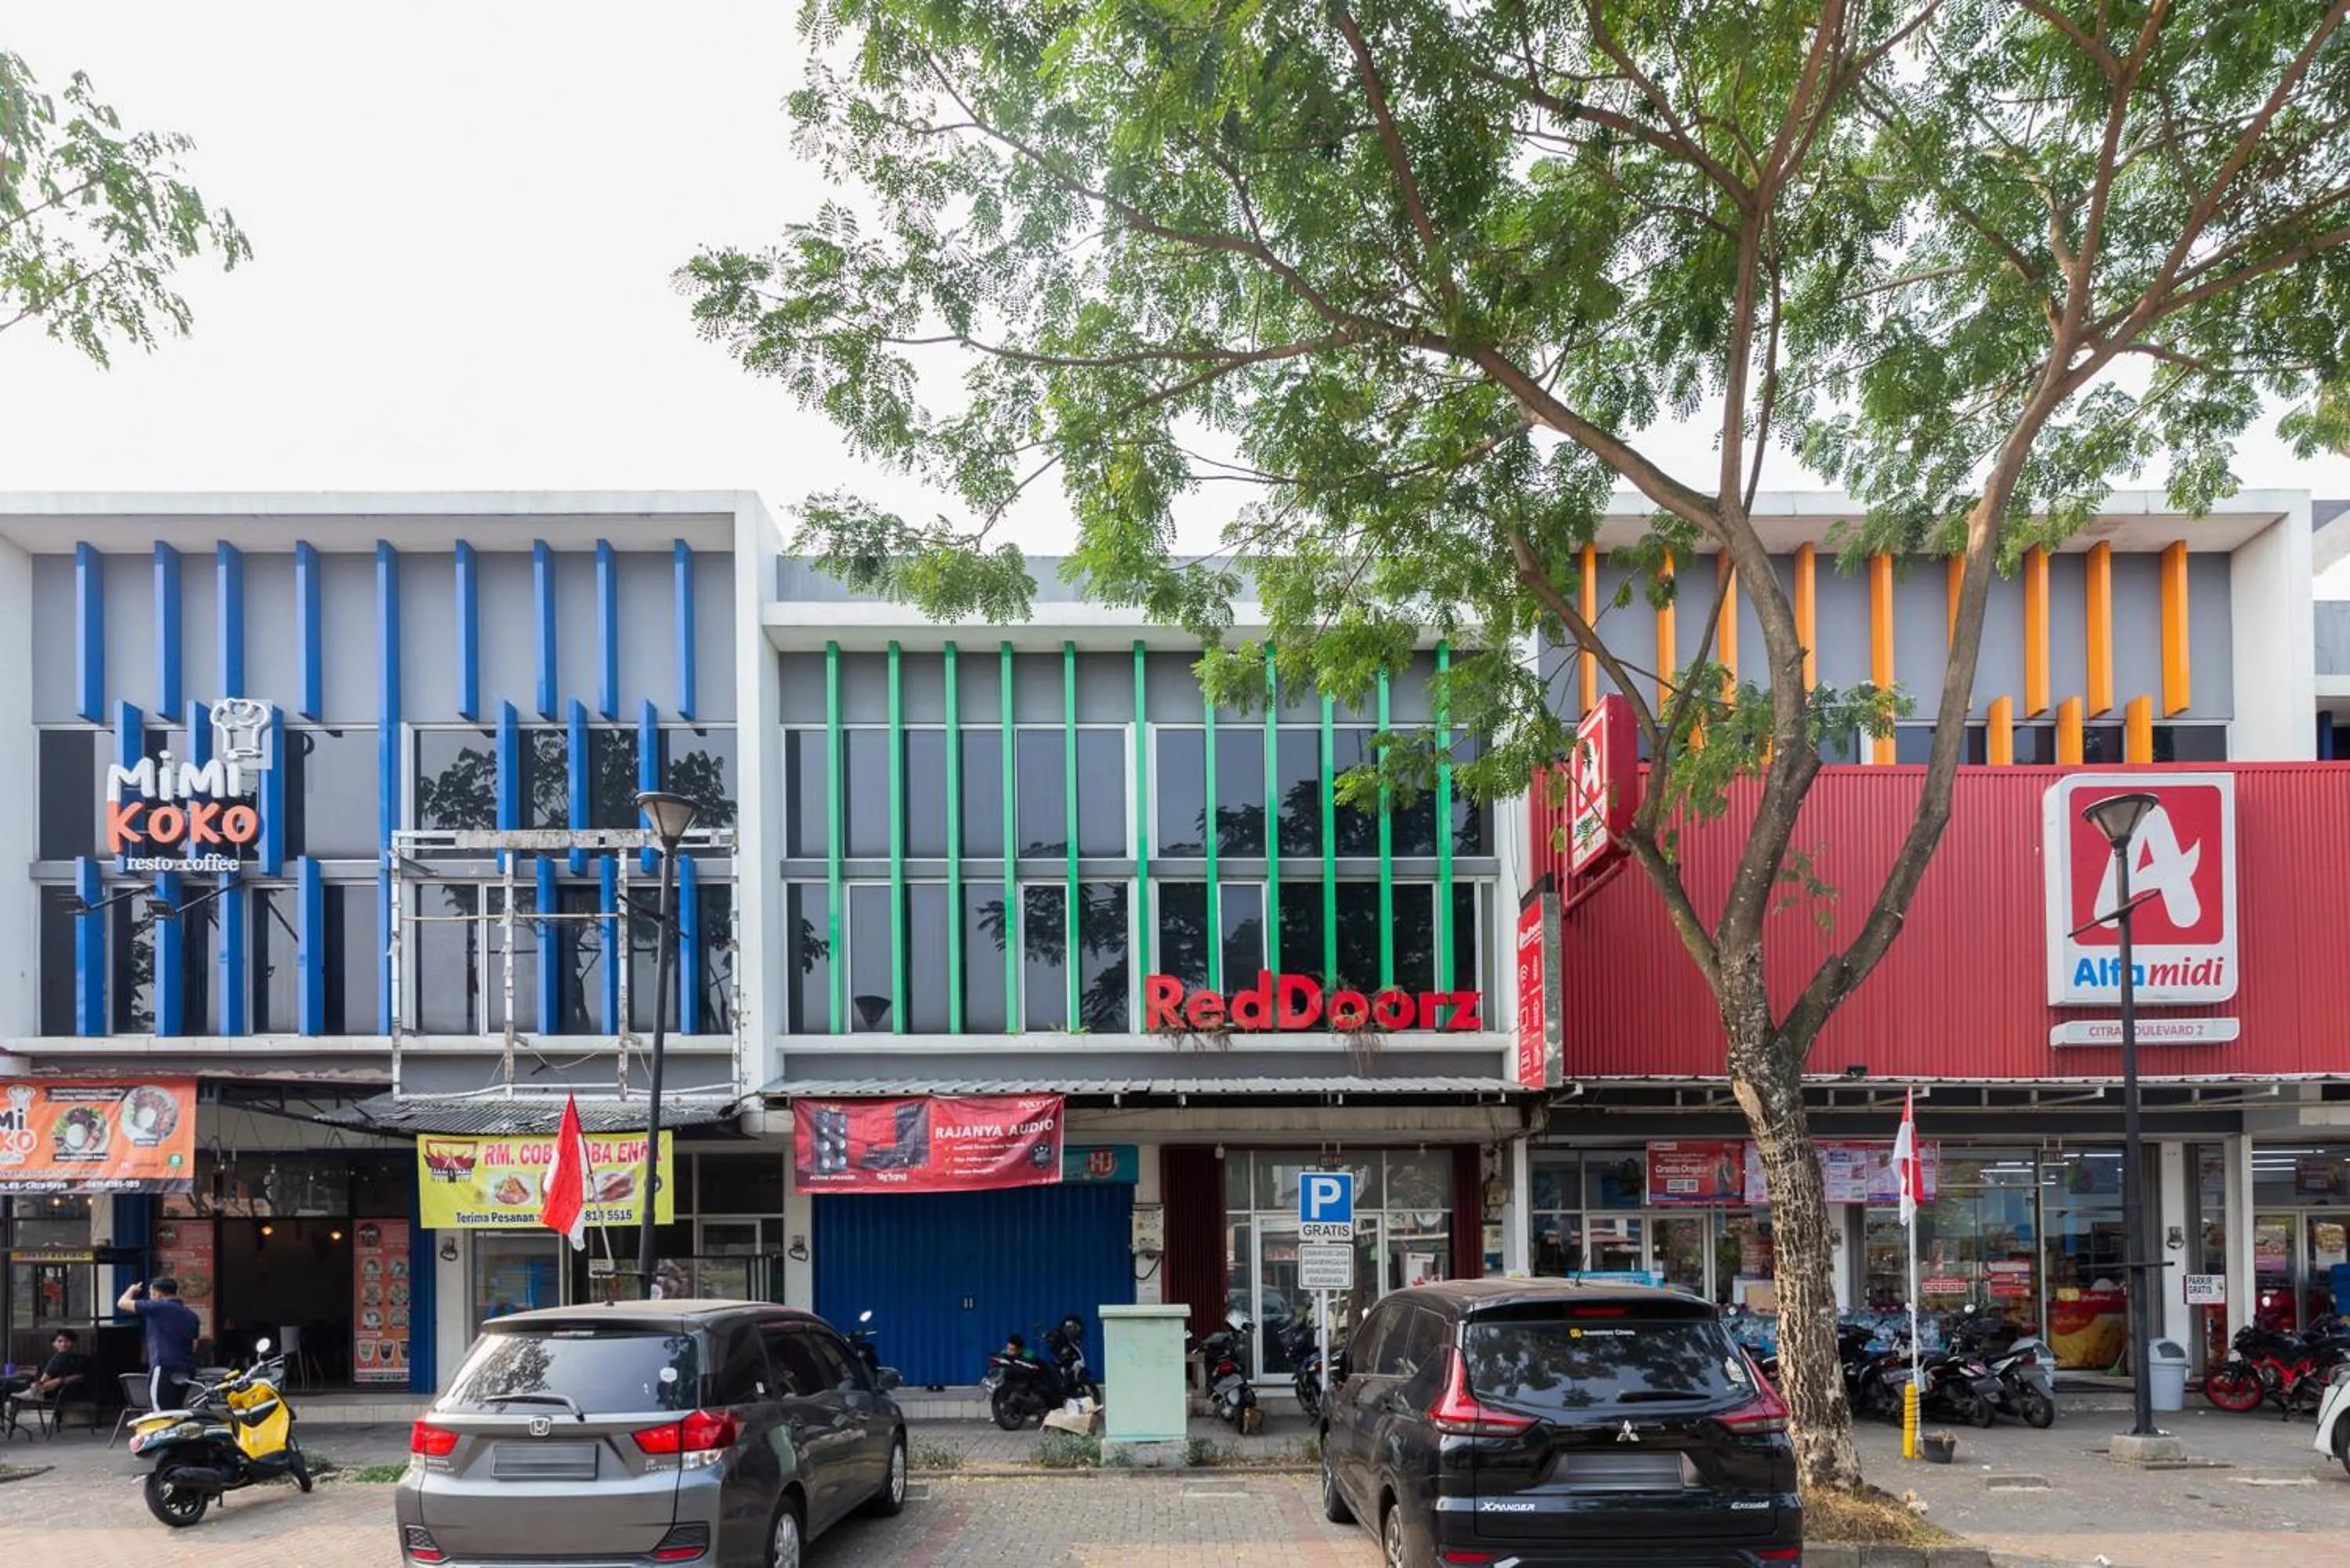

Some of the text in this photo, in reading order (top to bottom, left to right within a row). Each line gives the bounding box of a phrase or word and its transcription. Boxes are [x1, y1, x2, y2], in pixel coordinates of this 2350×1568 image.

[107, 800, 260, 852] KOKO
[127, 853, 239, 871] resto coffee
[1145, 969, 1482, 1031] RedDoorz
[2089, 1026, 2121, 1037] CITRA
[2132, 1024, 2193, 1036] OULEVARD
[935, 1119, 1054, 1139] RAJANYA AUDIO
[484, 1144, 515, 1165] RM.
[520, 1143, 553, 1165] COB
[1311, 1177, 1342, 1219] P
[456, 1212, 489, 1223] Terima
[492, 1212, 535, 1223] Pesanan
[1303, 1225, 1350, 1237] GRATIS
